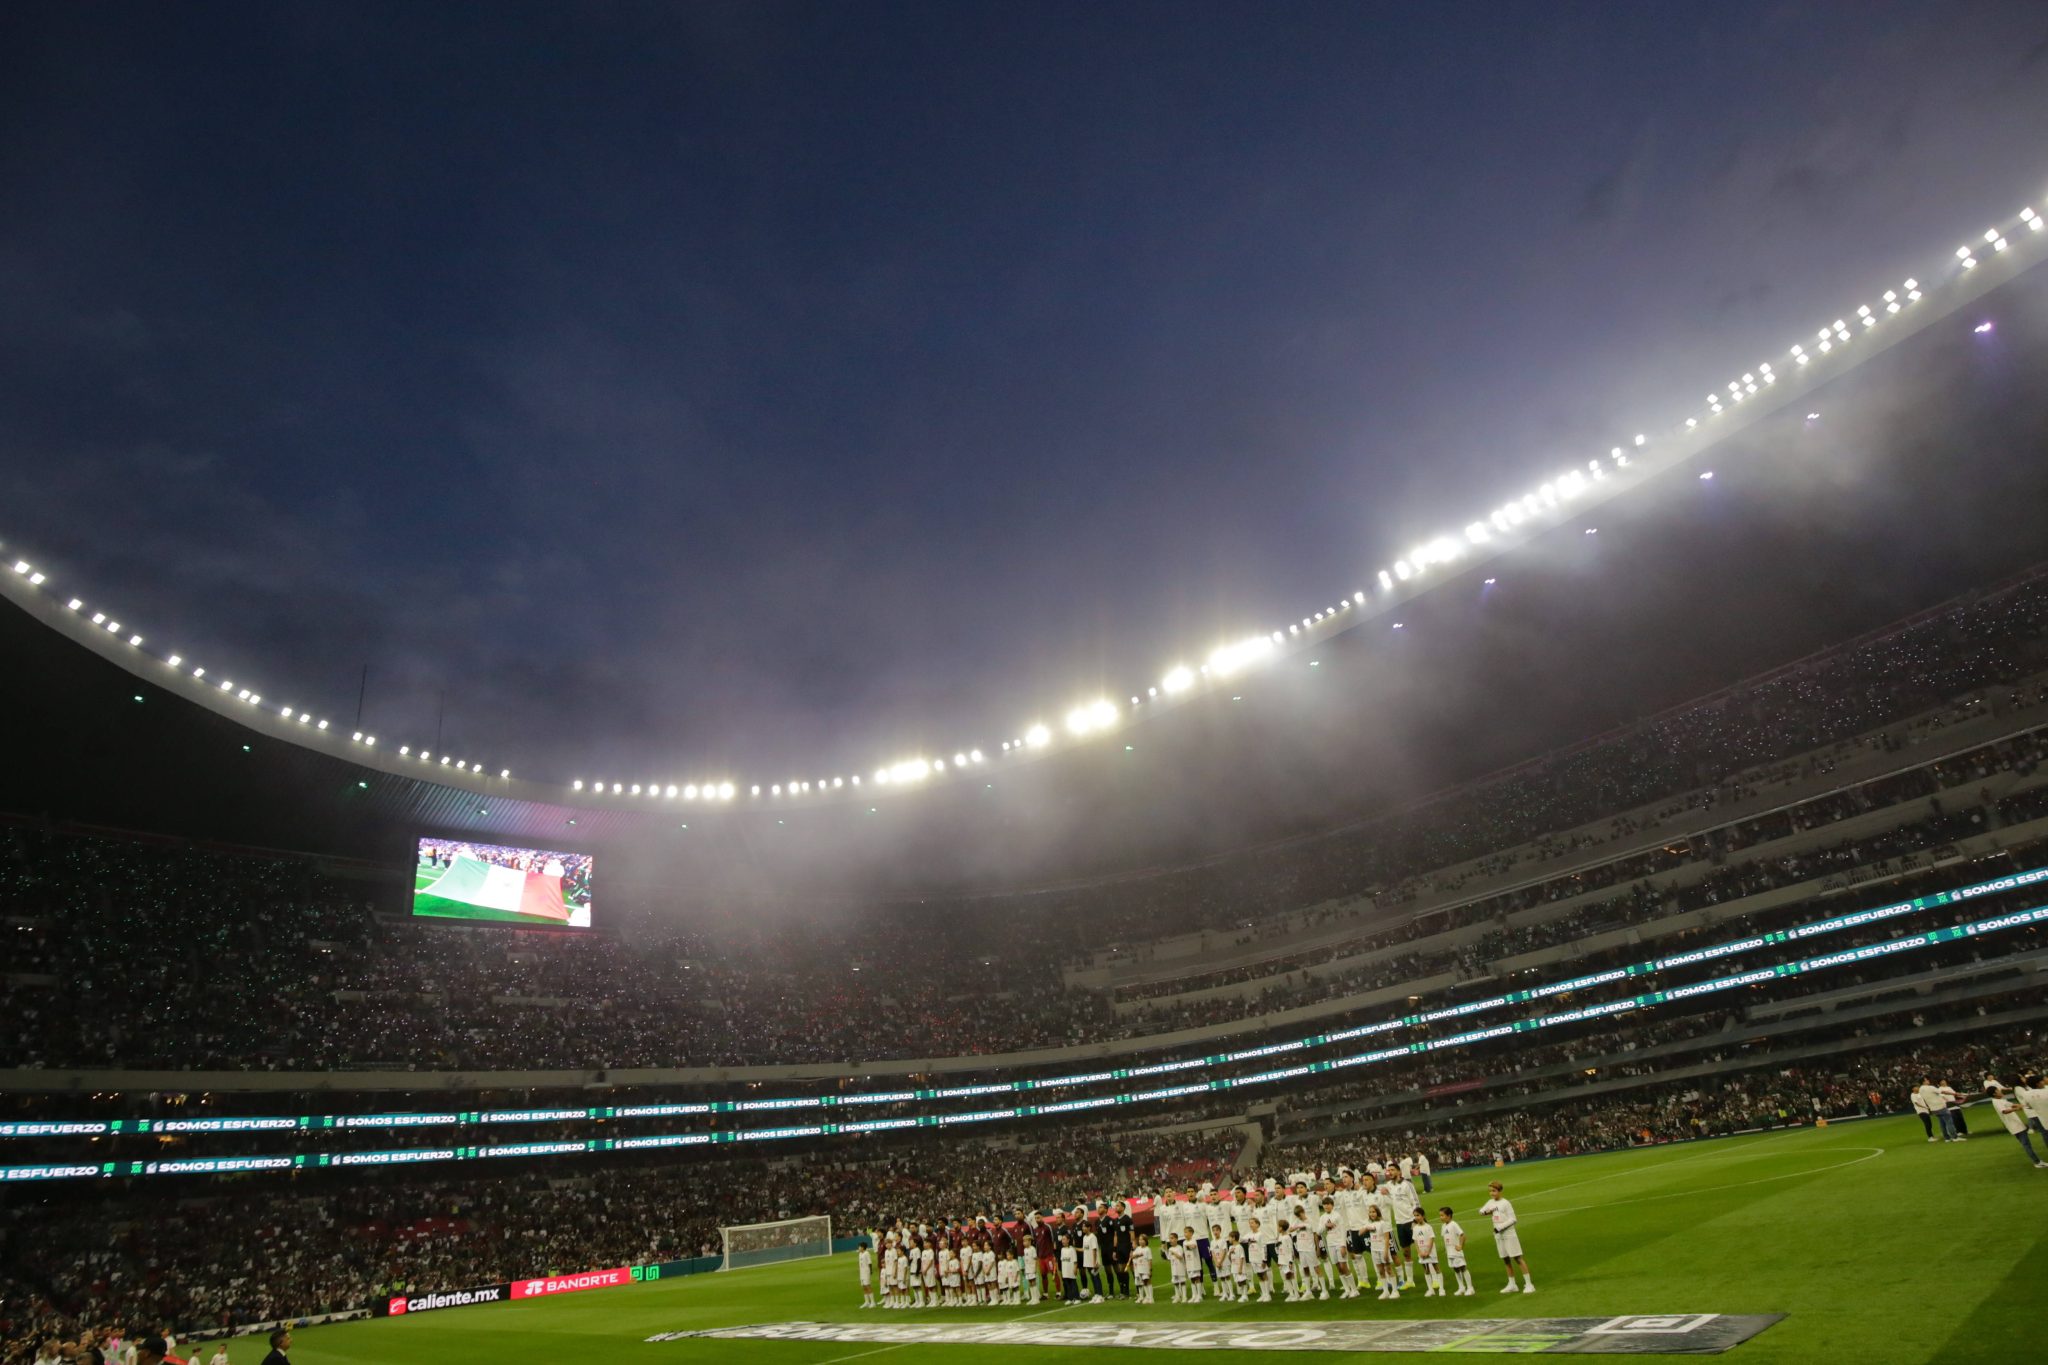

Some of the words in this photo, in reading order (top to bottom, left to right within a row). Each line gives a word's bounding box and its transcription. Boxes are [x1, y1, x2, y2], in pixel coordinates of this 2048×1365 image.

[1963, 878, 2015, 897] SOMOS
[1798, 919, 1842, 936] SOMOS
[1845, 903, 1911, 925] ESFUERZO
[1978, 913, 2031, 931] SOMOS
[1664, 952, 1703, 966] SOMOS
[1705, 938, 1763, 957] ESFUERZO
[1810, 952, 1855, 968] SOMOS
[1858, 937, 1925, 958] ESFUERZO
[1539, 983, 1573, 996] SOMOS
[1575, 970, 1625, 987] ESFUERZO
[1674, 983, 1713, 997] SOMOS
[1716, 970, 1774, 988] ESFUERZO
[1427, 1008, 1458, 1020] SOMOS
[1460, 998, 1504, 1013] ESFUERZO
[1547, 1011, 1581, 1024] SOMOS
[1584, 1000, 1635, 1016] ESFUERZO
[1332, 1029, 1360, 1040] SOMOS
[1362, 1020, 1403, 1034] ESFUERZO
[1434, 1035, 1465, 1047] SOMOS
[1467, 1026, 1512, 1041] ESFUERZO
[1234, 1049, 1262, 1059] SOMOS
[1263, 1041, 1303, 1054] ESFUERZO
[1338, 1055, 1366, 1067] SOMOS
[1368, 1047, 1409, 1061] ESFUERZO
[1133, 1065, 1163, 1075] SOMOS
[1165, 1059, 1205, 1071] ESFUERZO
[1041, 1077, 1069, 1086] SOMOS
[1071, 1072, 1111, 1083] ESFUERZO
[1238, 1074, 1267, 1084] SOMOS
[1268, 1066, 1308, 1079] ESFUERZO
[844, 1095, 873, 1103] SOMOS
[874, 1092, 914, 1101] ESFUERZO
[943, 1088, 970, 1097] SOMOS
[972, 1084, 1012, 1094] ESFUERZO
[1138, 1090, 1167, 1100] SOMOS
[1168, 1084, 1209, 1095] ESFUERZO
[624, 1107, 659, 1115] SOMOS
[661, 1104, 709, 1114] ESFUERZO
[743, 1101, 774, 1109] SOMOS
[776, 1098, 819, 1107] ESFUERZO
[1044, 1103, 1073, 1112] SOMOS
[1074, 1097, 1115, 1108] ESFUERZO
[347, 1117, 392, 1126] SOMOS
[395, 1115, 456, 1124] ESFUERZO
[490, 1112, 530, 1121] SOMOS
[532, 1110, 586, 1120] ESFUERZO
[945, 1114, 973, 1122] SOMOS
[974, 1110, 1014, 1120] ESFUERZO
[17, 1123, 106, 1134] ESFUERZO
[166, 1120, 220, 1130] SOMOS
[223, 1119, 296, 1129] ESFUERZO
[845, 1122, 874, 1130] SOMOS
[876, 1119, 916, 1128] ESFUERZO
[744, 1130, 775, 1139] SOMOS
[777, 1127, 821, 1136] ESFUERZO
[488, 1146, 528, 1155] SOMOS
[531, 1142, 585, 1153] ESFUERZO
[623, 1138, 659, 1147] SOMOS
[661, 1135, 709, 1145] ESFUERZO
[343, 1153, 389, 1163] SOMOS
[391, 1150, 453, 1161] ESFUERZO
[8, 1166, 98, 1178] ESFUERZO
[159, 1161, 214, 1172] SOMOS
[218, 1158, 291, 1169] ESFUERZO
[547, 1273, 619, 1292] BANORTE
[407, 1288, 500, 1312] caliente.mx
